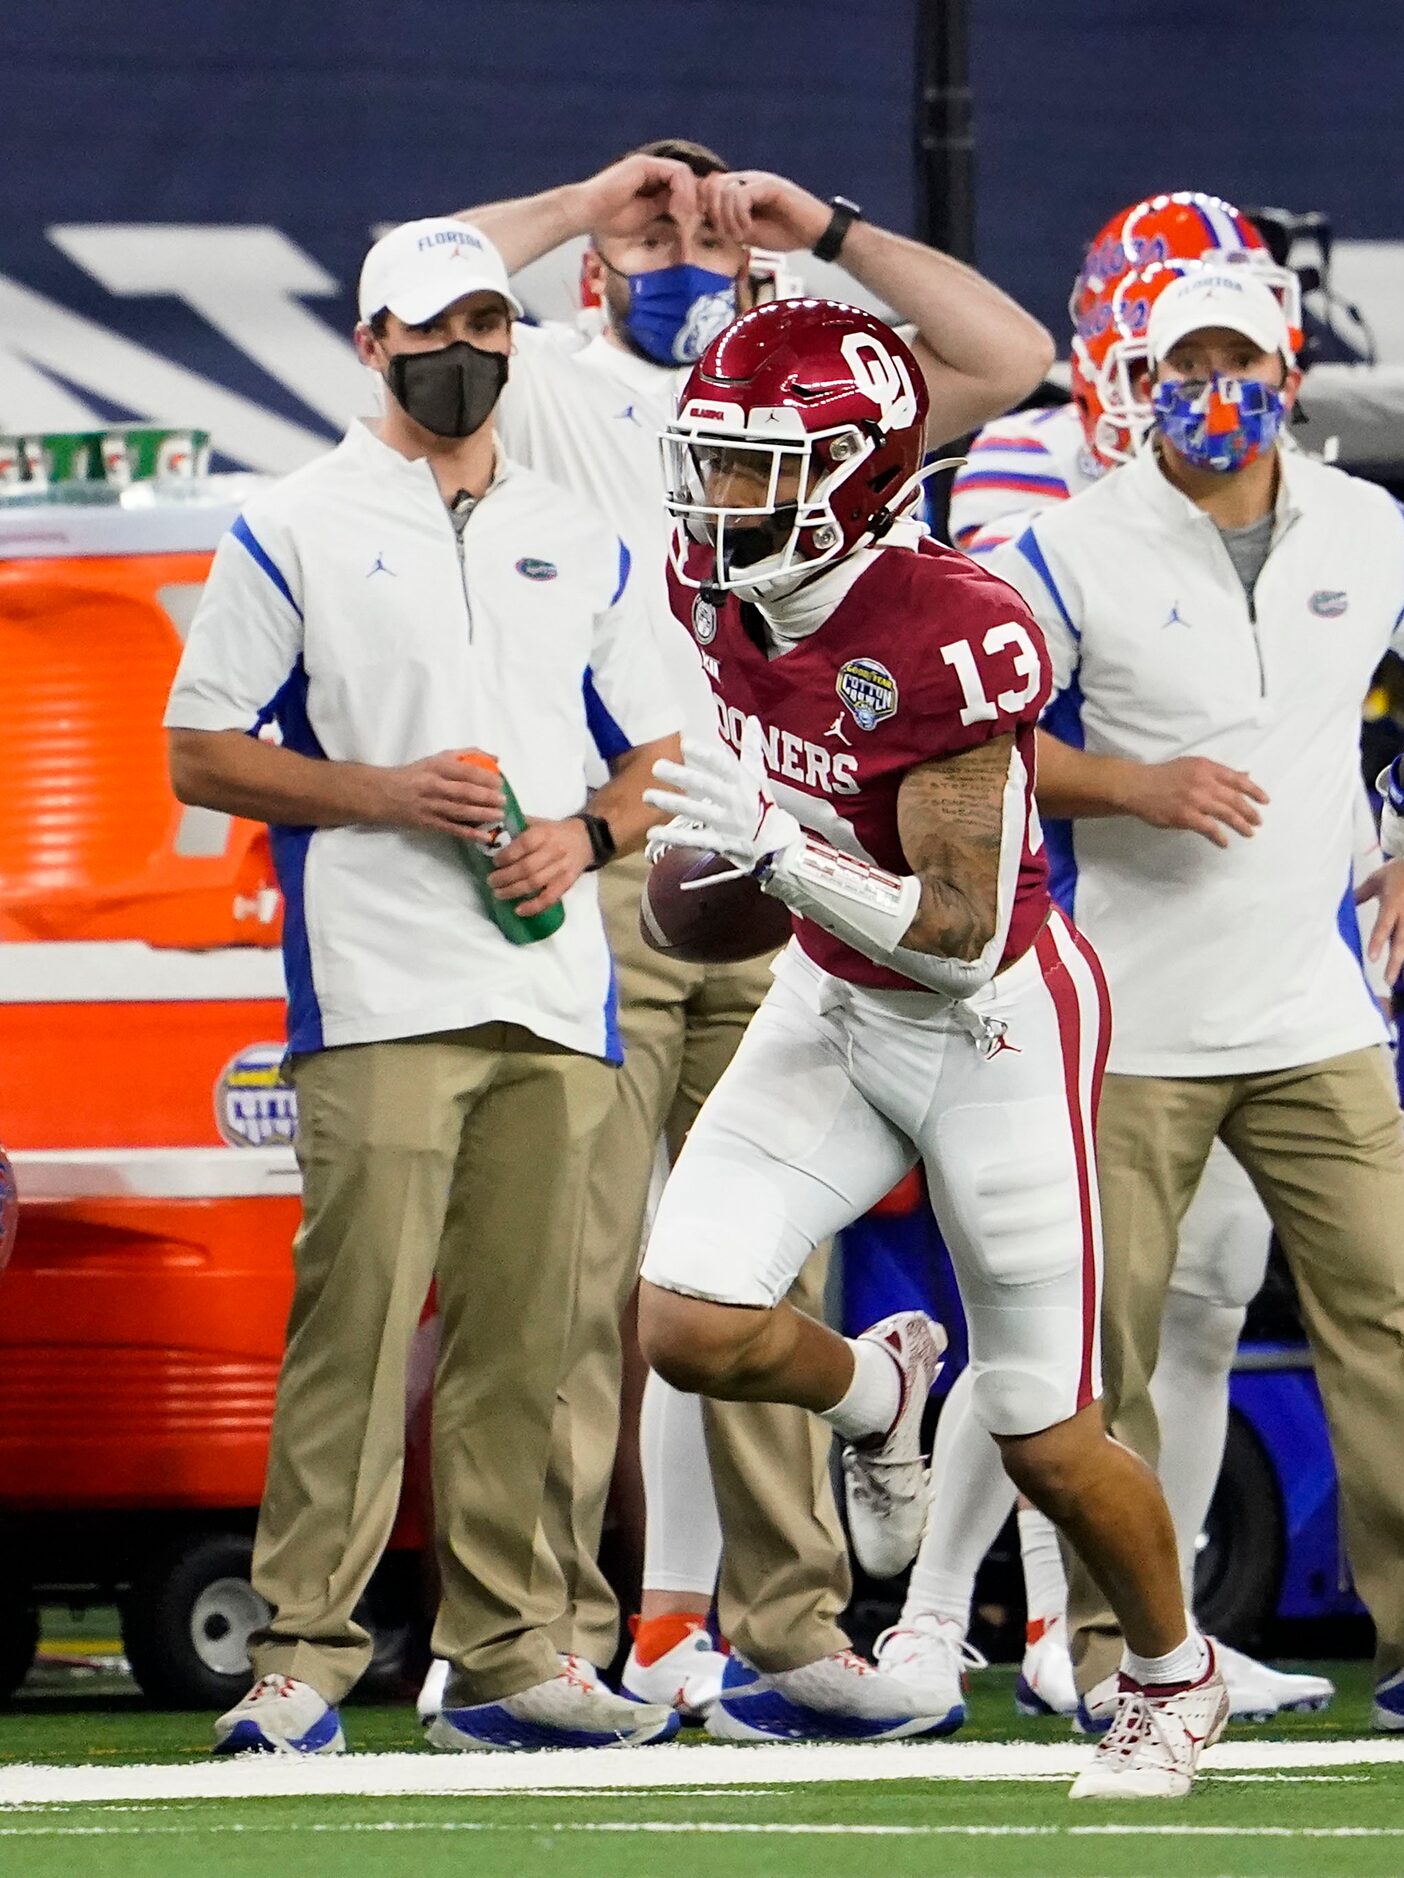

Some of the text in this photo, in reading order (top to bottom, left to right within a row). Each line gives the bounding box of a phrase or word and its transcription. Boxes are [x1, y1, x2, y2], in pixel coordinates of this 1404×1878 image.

[418, 232, 484, 252] FLORIDA
[846, 664, 893, 689] GOODYEAR
[940, 621, 1041, 727] 13
[842, 673, 892, 709] COTTON
